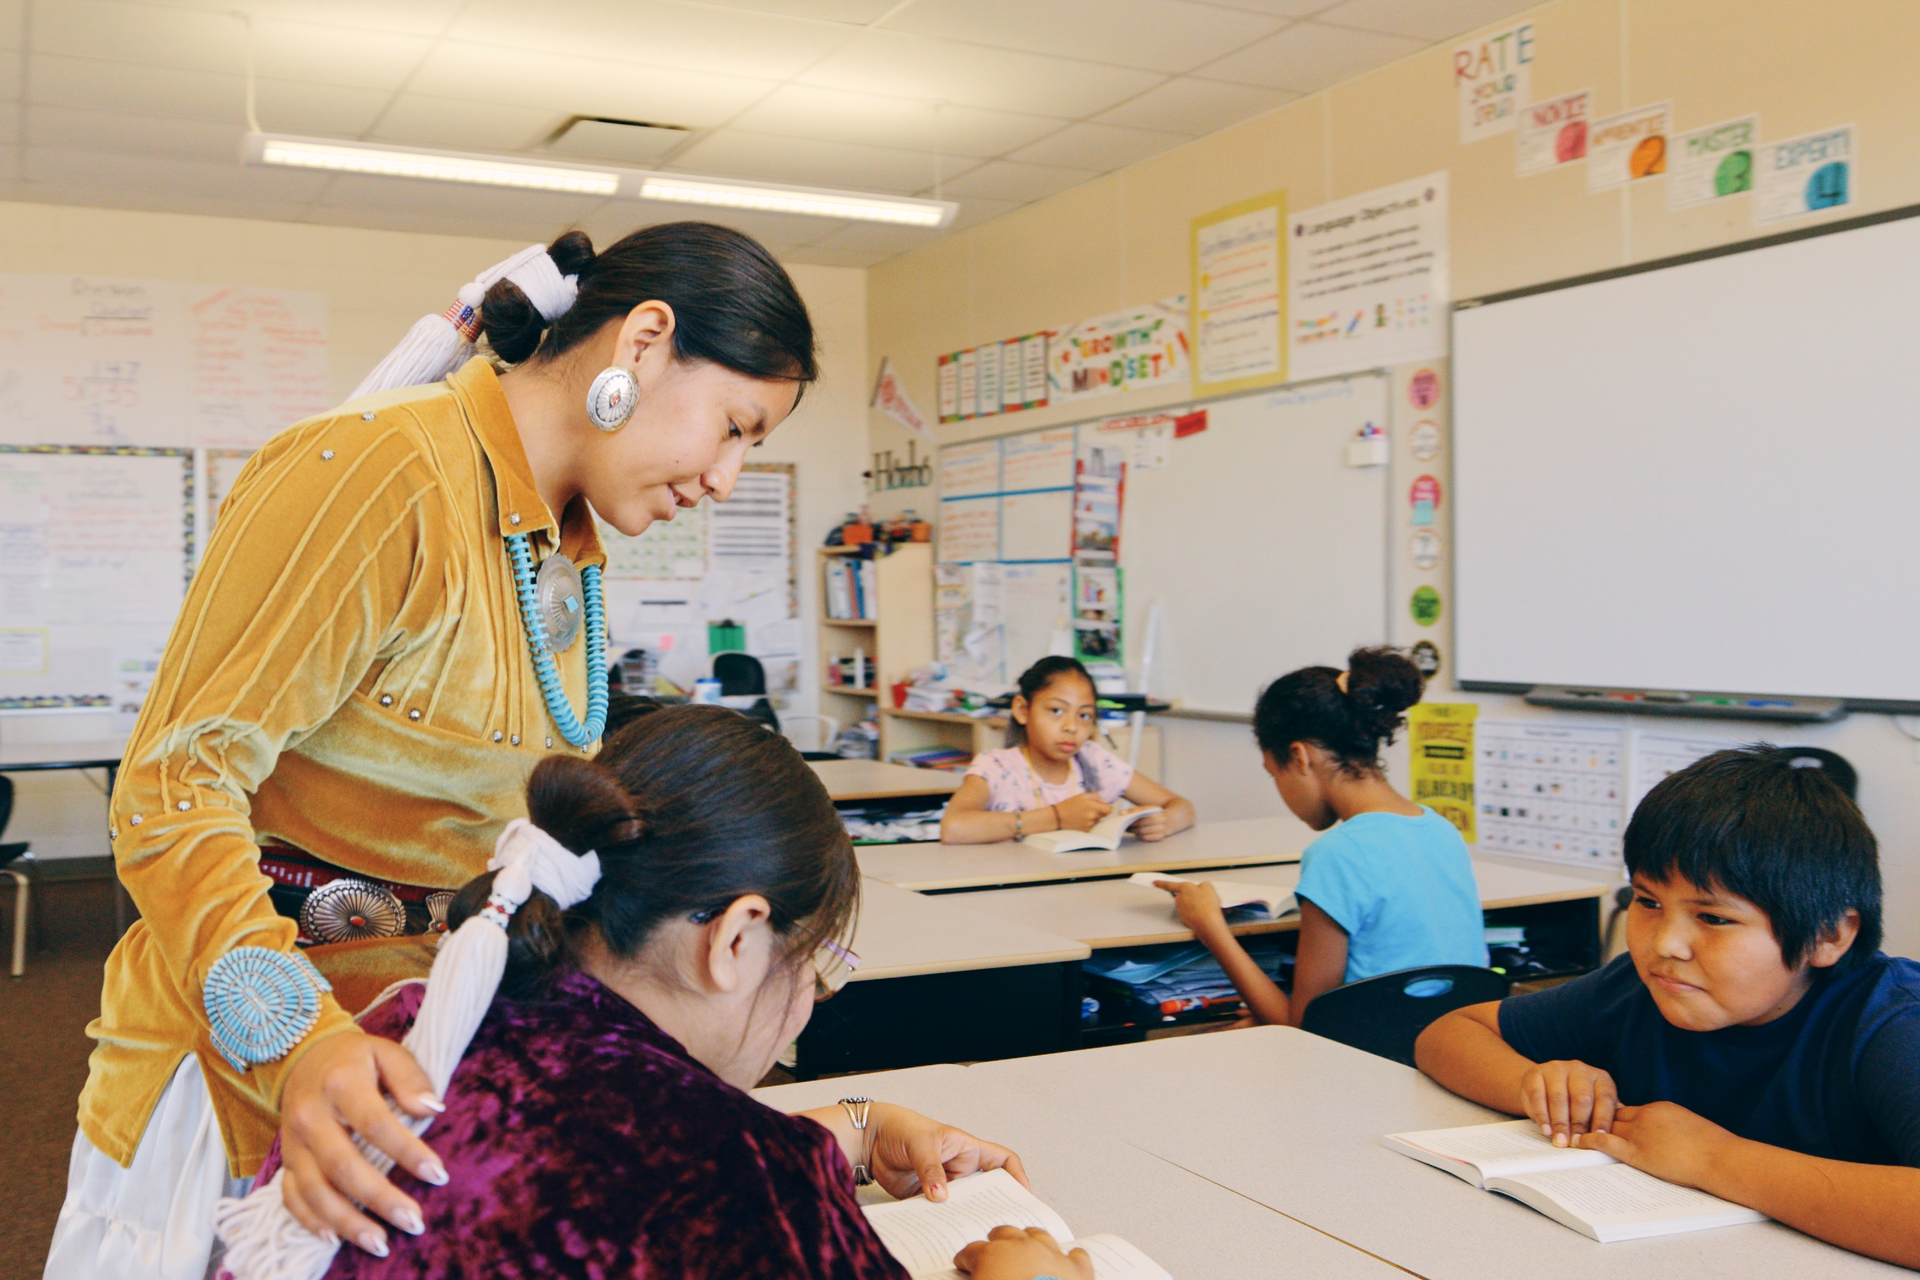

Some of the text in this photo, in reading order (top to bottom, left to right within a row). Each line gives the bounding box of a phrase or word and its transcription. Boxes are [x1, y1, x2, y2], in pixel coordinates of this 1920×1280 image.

[1454, 24, 1534, 88] RATE
[1640, 134, 1666, 177] 2
[1686, 122, 1753, 157] MASTER
[1813, 160, 1846, 207] 4
[1080, 325, 1152, 359] GROWTH
[1071, 352, 1163, 394] MINDSET
